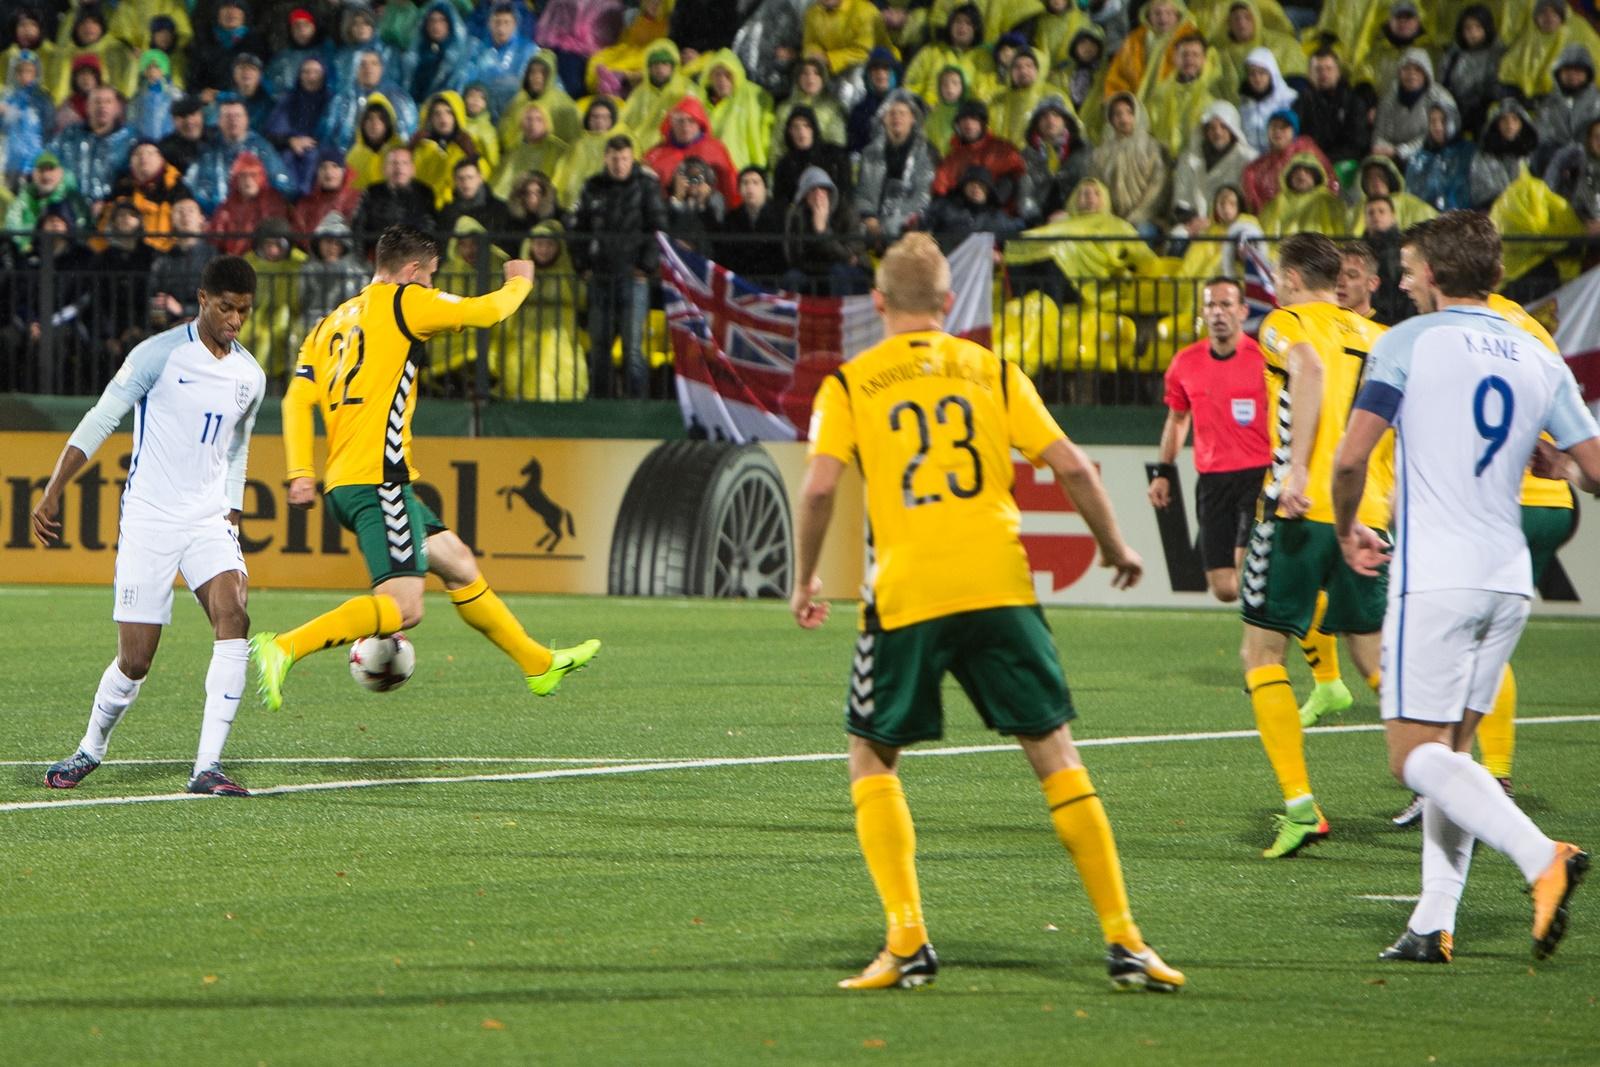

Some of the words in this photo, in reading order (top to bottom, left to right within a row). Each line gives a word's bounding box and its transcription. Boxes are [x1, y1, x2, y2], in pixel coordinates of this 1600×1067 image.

[329, 325, 365, 411] 22
[1463, 332, 1520, 362] KANE
[200, 411, 223, 446] 11
[889, 395, 984, 509] 23
[1473, 374, 1514, 478] 9
